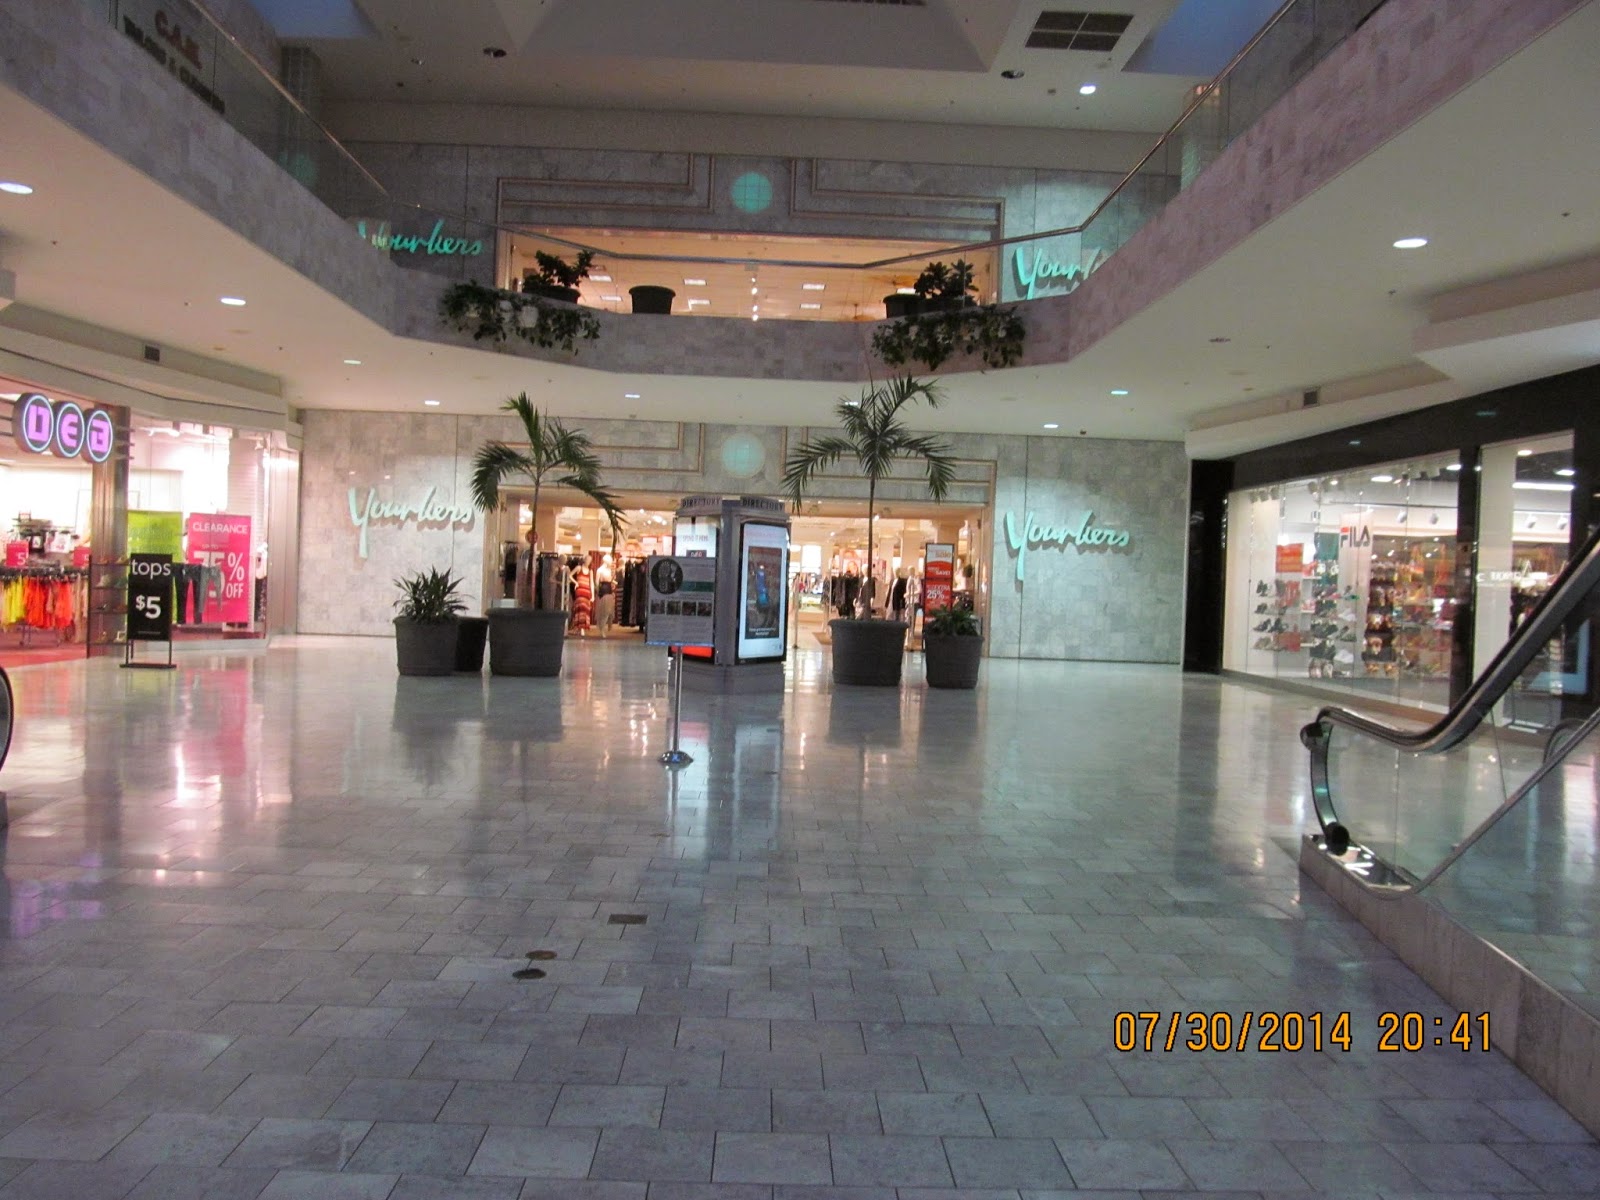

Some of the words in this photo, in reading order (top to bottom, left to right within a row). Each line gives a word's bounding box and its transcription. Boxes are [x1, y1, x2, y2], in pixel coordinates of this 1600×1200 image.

[742, 498, 783, 510] DIRECTORY
[192, 521, 248, 534] CLEARANCE
[1340, 525, 1370, 548] FILA
[132, 559, 171, 580] tops
[226, 583, 244, 598] OFF
[135, 595, 162, 619] $5
